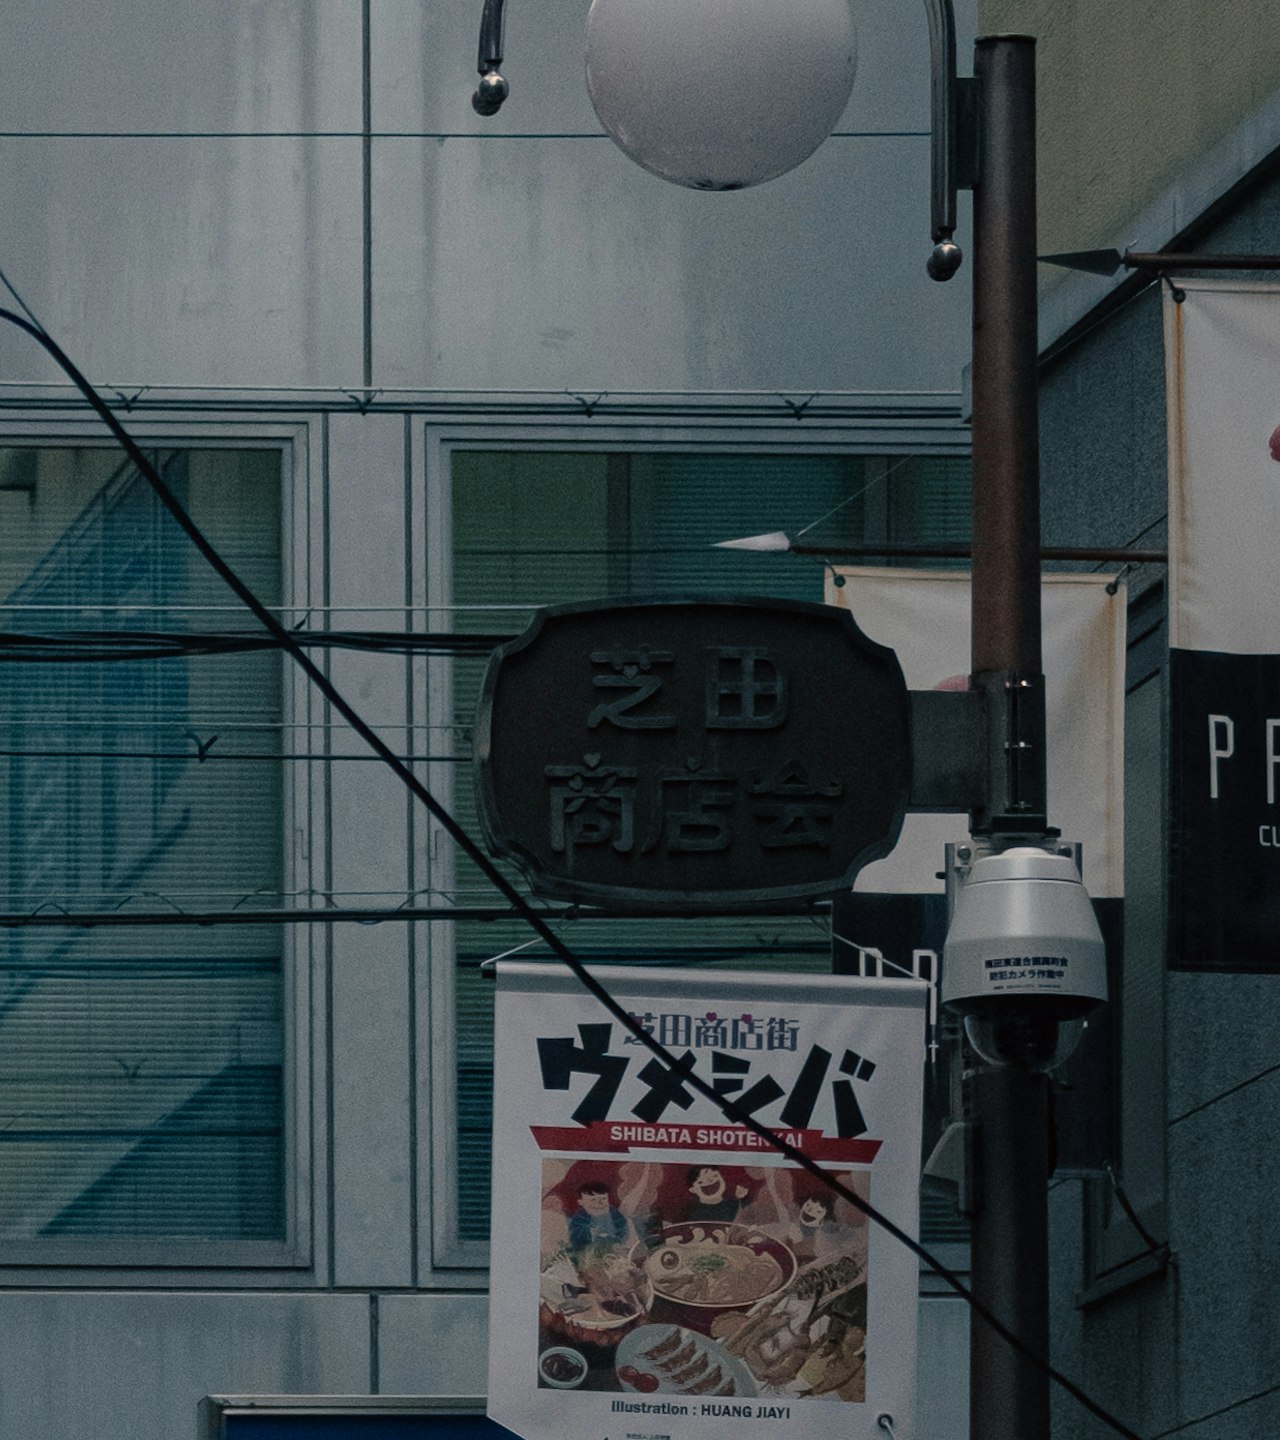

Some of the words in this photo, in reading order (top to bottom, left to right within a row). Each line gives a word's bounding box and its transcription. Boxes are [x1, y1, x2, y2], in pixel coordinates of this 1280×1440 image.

[587, 644, 790, 732] 芝田
[543, 754, 845, 857] 商店会
[536, 1023, 877, 1140] ウメシバ
[610, 1125, 692, 1144] SHIBATA
[611, 1400, 688, 1416] Illustration
[701, 1404, 752, 1419] HUANG
[756, 1406, 791, 1420] JIAYI
